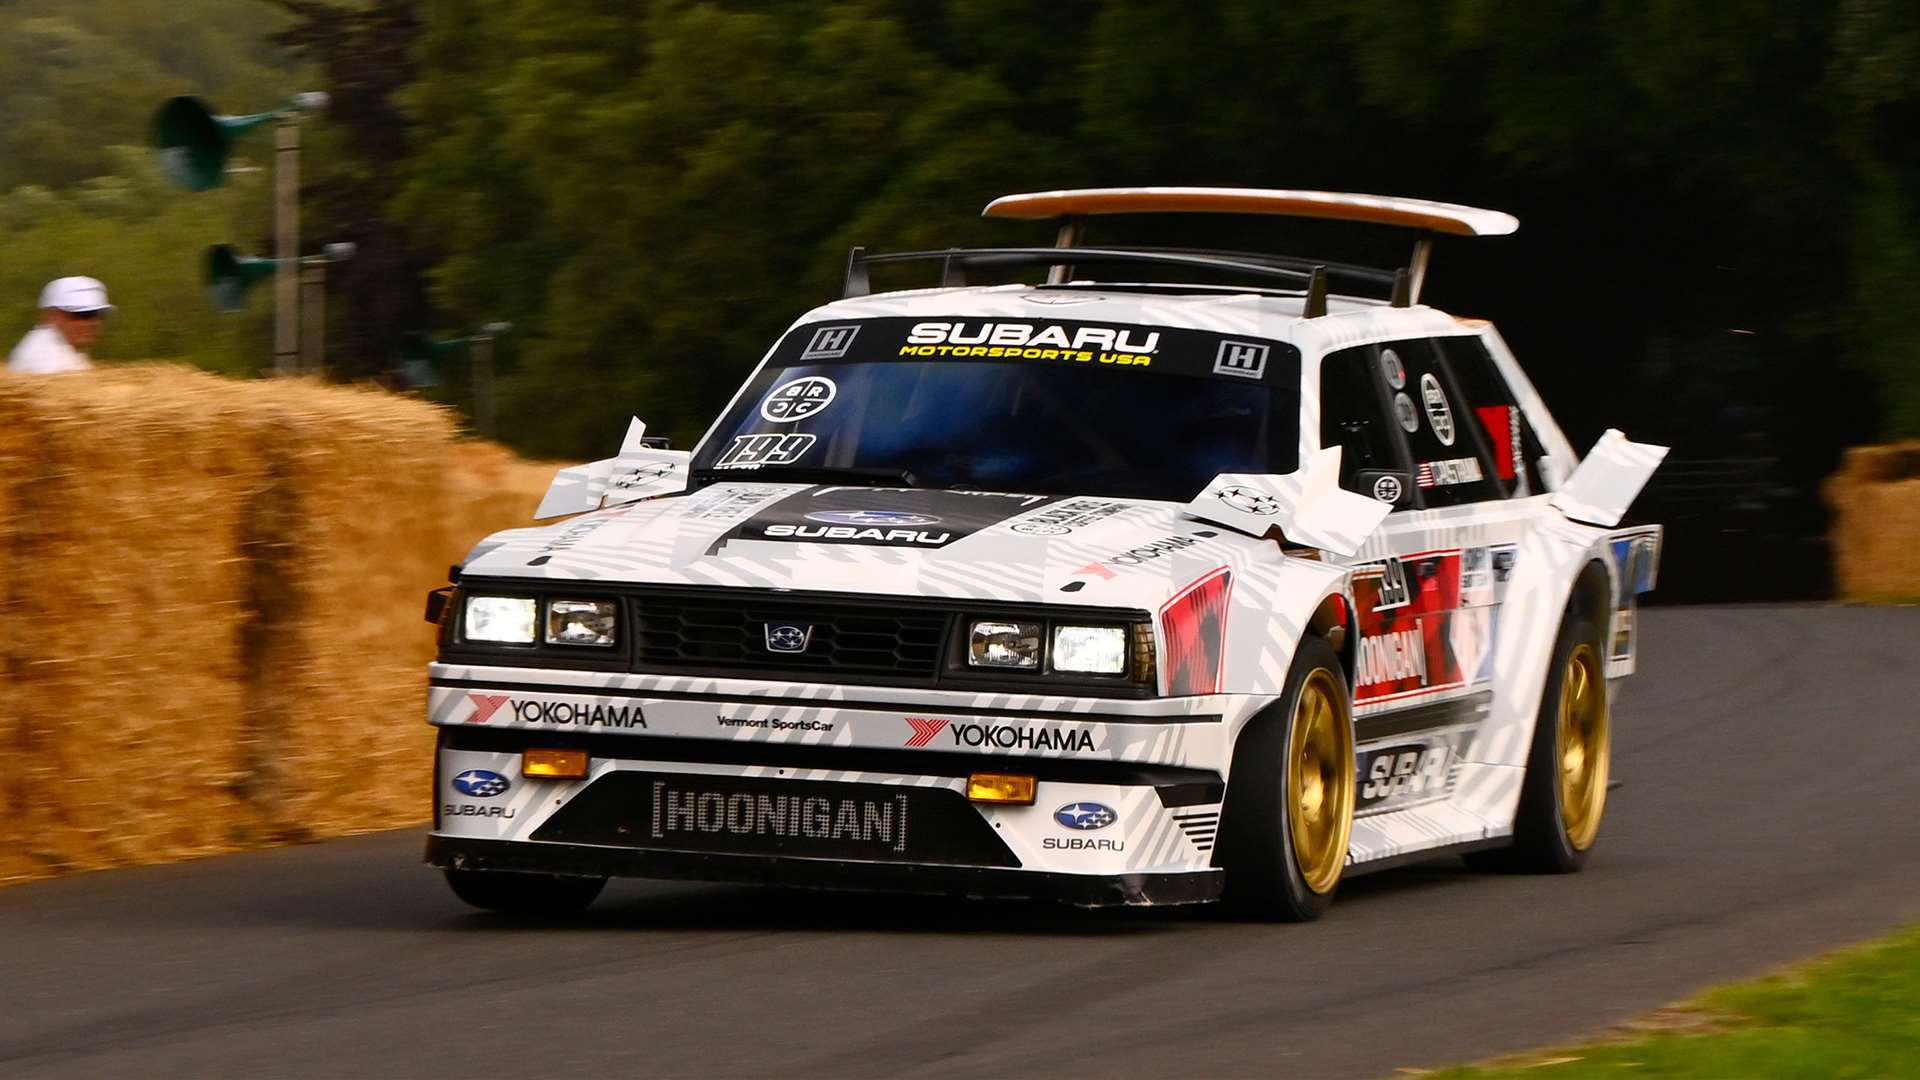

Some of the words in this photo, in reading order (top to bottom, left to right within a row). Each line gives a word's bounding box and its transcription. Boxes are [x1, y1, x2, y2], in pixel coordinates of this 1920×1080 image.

[907, 322, 1160, 354] SUBARU
[899, 345, 1093, 362] MOTORSPORTS
[1099, 353, 1152, 367] USA
[715, 433, 817, 466] 199
[764, 524, 950, 544] SUBARU
[510, 699, 647, 729] YOKOHAMA
[716, 715, 768, 728] Vermont
[771, 718, 834, 731] SportsCar
[950, 723, 1096, 752] YOKOHAMA
[443, 803, 516, 819] SUBARU
[1042, 837, 1125, 852] SUBARU
